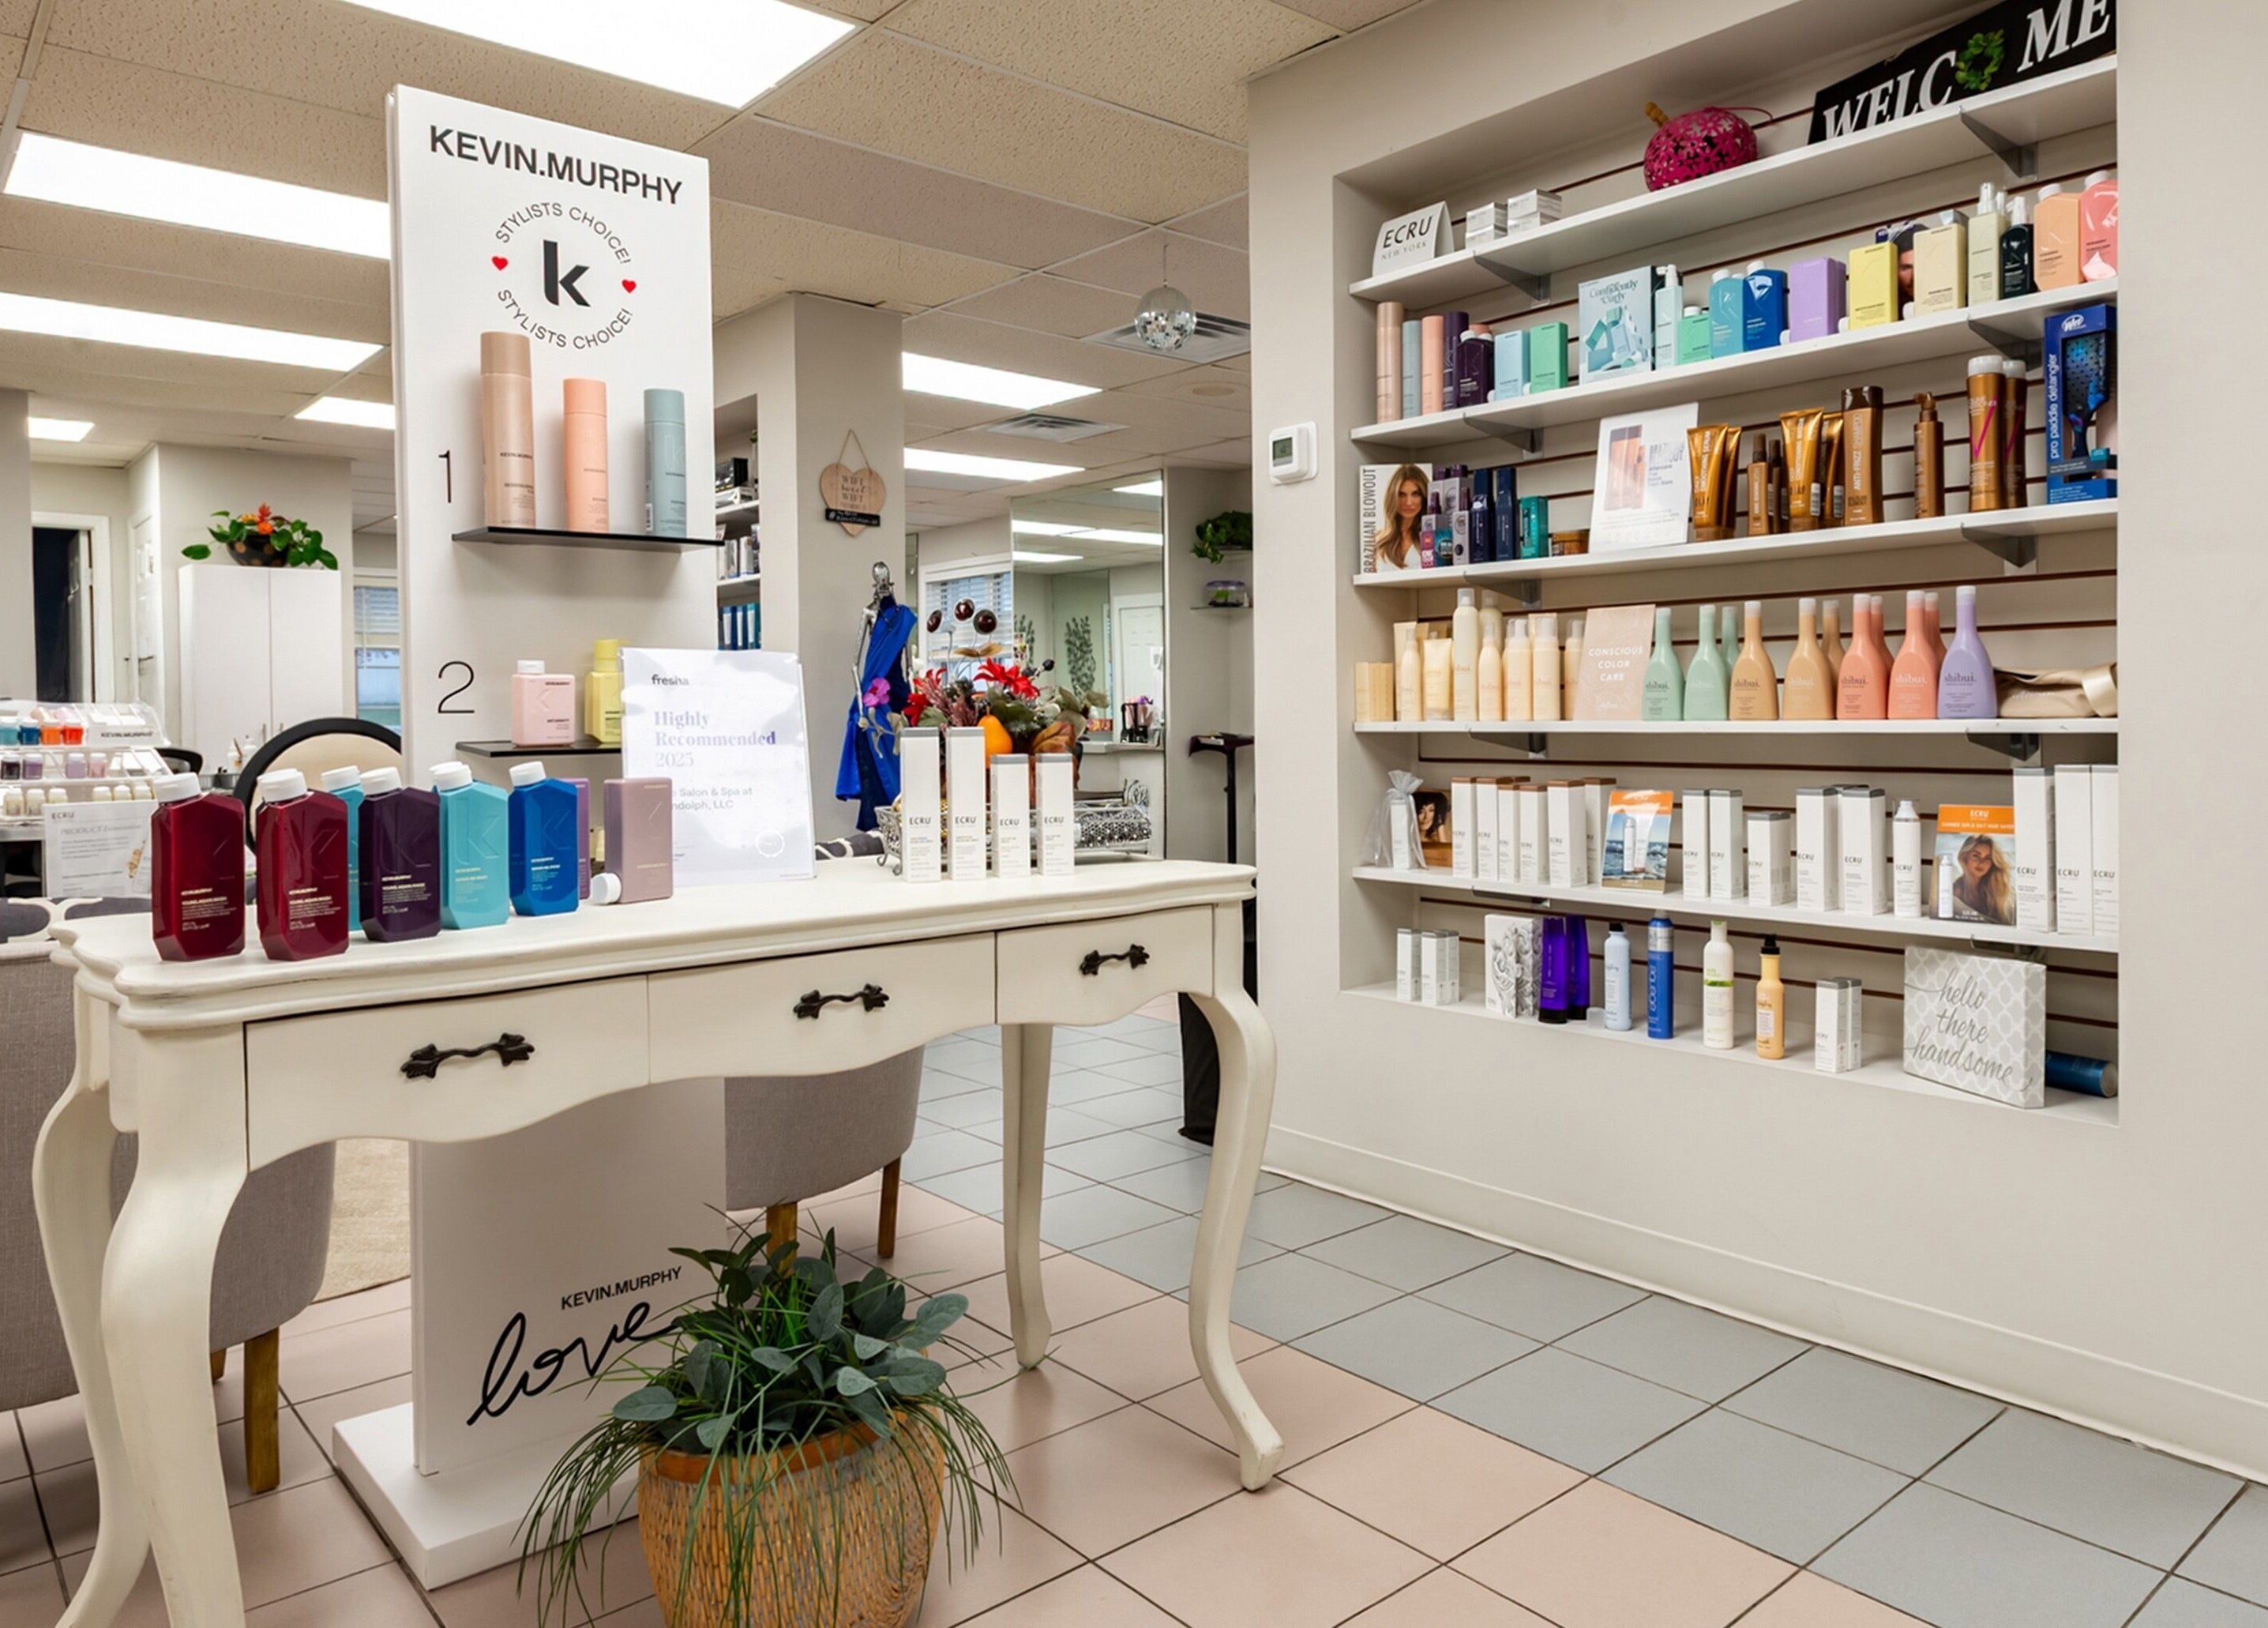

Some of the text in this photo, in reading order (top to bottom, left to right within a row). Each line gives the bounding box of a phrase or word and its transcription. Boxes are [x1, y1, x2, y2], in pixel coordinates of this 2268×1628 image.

[430, 125, 683, 205] KEVIN.MURPHY
[495, 202, 632, 265] STYLISTS CHOICE!
[1383, 216, 1434, 249] ECRU
[1382, 241, 1427, 260] NEW YORK
[498, 289, 633, 350] STYLISTS CHOICE!
[2048, 354, 2060, 458] pro paddle detangler
[438, 449, 451, 503] 1
[1362, 468, 1377, 573] BRAZILIAN BLOWOUT
[1588, 646, 1643, 656] CONSCIOUS
[1598, 660, 1631, 669] COLOR
[651, 674, 689, 686] fresha
[1600, 673, 1624, 682] CARE
[437, 660, 475, 714] 2
[654, 711, 710, 729] Highly
[655, 731, 776, 746] Recommended
[655, 752, 694, 768] 2025
[679, 787, 708, 797] Salon
[722, 788, 740, 799] Spa
[672, 800, 734, 812] ndolph, LLC
[1969, 809, 1990, 818] ECRU
[51, 811, 75, 820] ECRU
[909, 816, 932, 825] ECRU
[955, 816, 976, 825] ECRU
[2057, 869, 2080, 878] ECRU
[2093, 870, 2115, 879] ECRU
[1904, 967, 1987, 1010] hello
[1935, 1008, 1988, 1044] there
[1903, 1025, 2033, 1092] handsome
[561, 1266, 682, 1310] KEVIN.MURPHY
[466, 1302, 680, 1426] love
